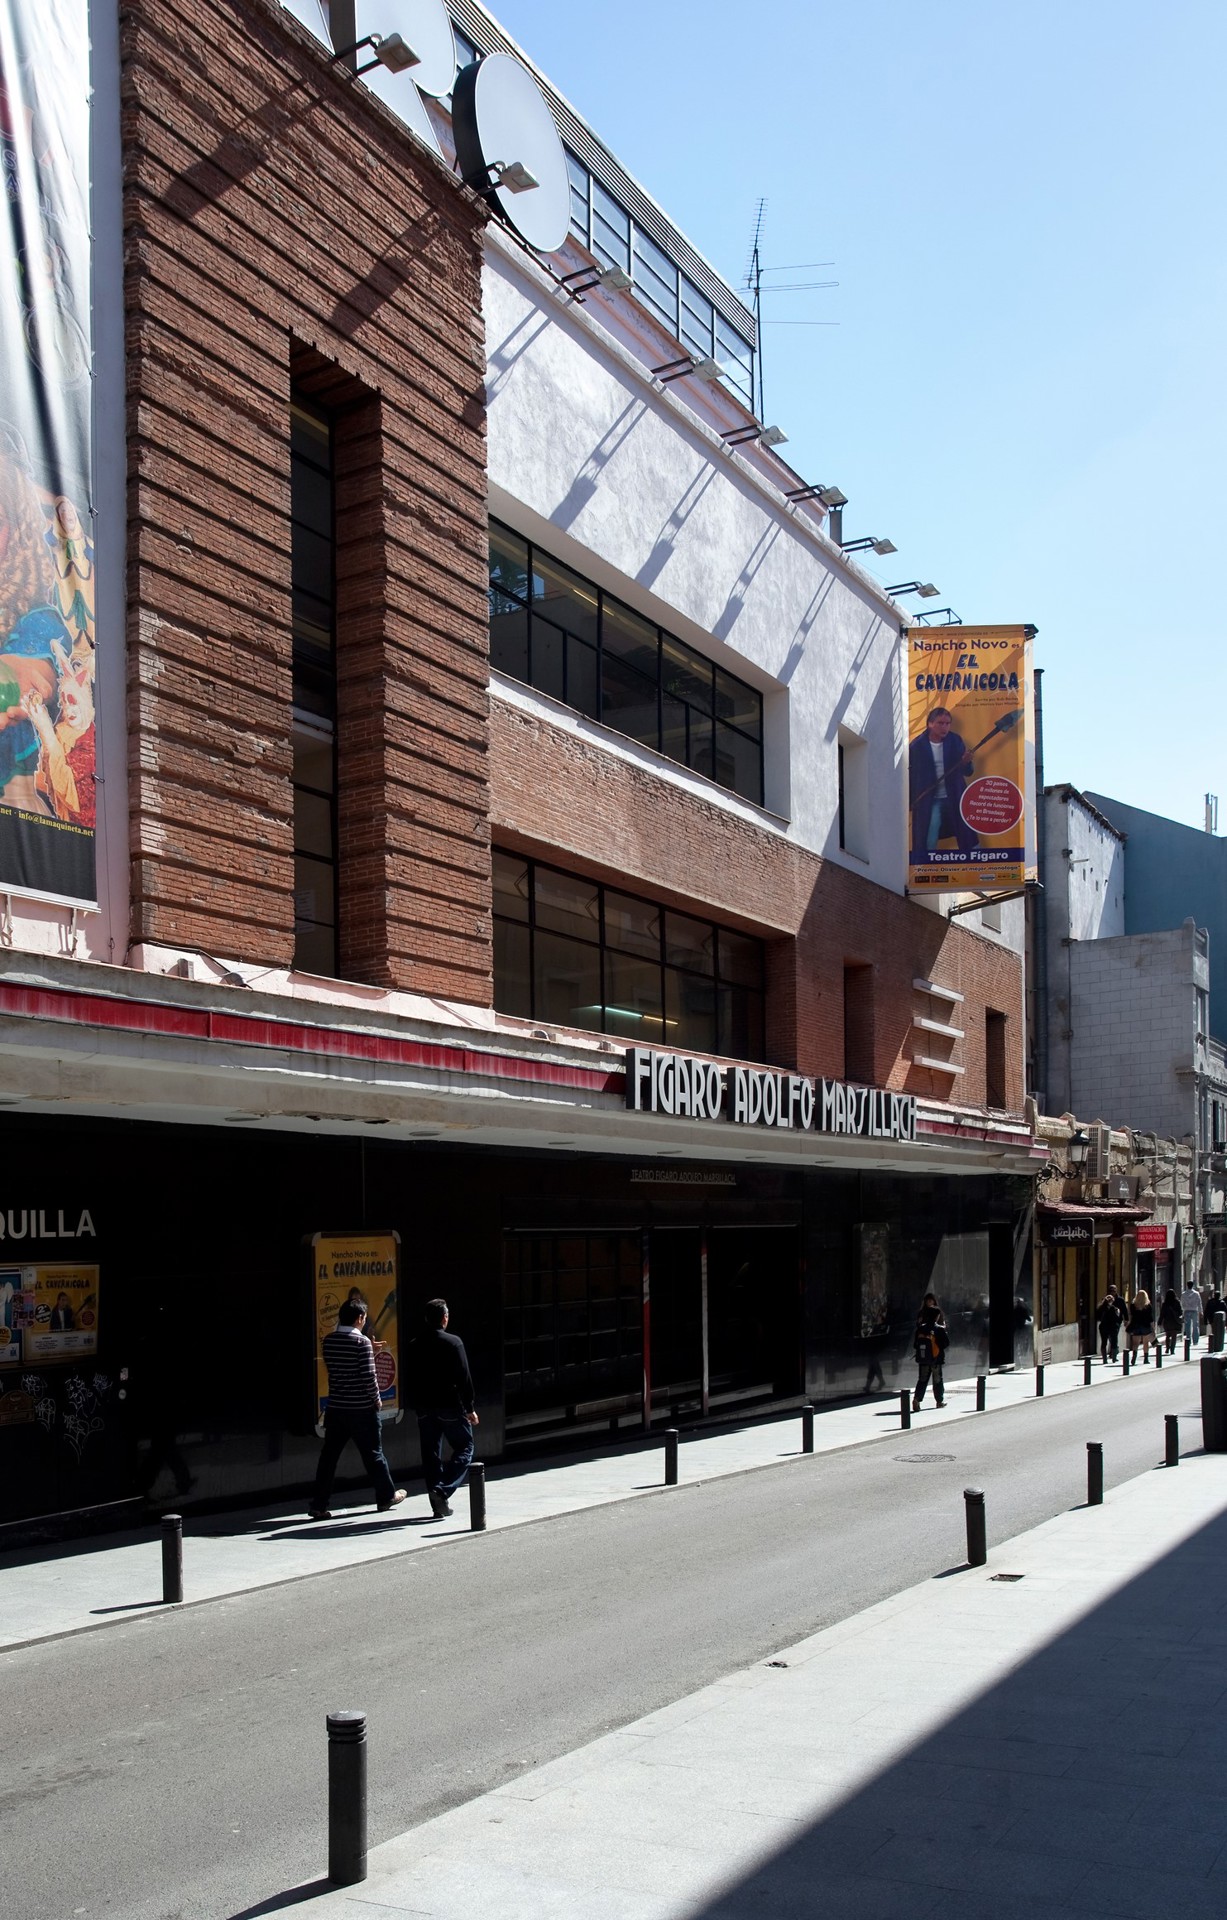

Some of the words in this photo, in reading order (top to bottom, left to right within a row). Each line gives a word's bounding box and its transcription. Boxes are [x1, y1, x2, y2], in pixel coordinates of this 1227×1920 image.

[914, 640, 967, 651] Nancho
[971, 639, 1008, 649] Novo
[956, 653, 979, 669] EL
[915, 672, 1019, 692] CAVERNICOLA
[982, 808, 1006, 816] Broadway
[18, 810, 94, 837] info@lamaquineta.net
[927, 852, 966, 862] Teatro
[632, 1047, 723, 1120] FIGARO
[733, 1066, 813, 1130] ADOLFO
[820, 1077, 919, 1140] MARSILLACH
[631, 1169, 654, 1180] TEATRO
[656, 1170, 678, 1181] FIGARO
[680, 1171, 702, 1182] ADOLFO
[331, 1250, 354, 1259] Nancho
[318, 1264, 328, 1280] EL
